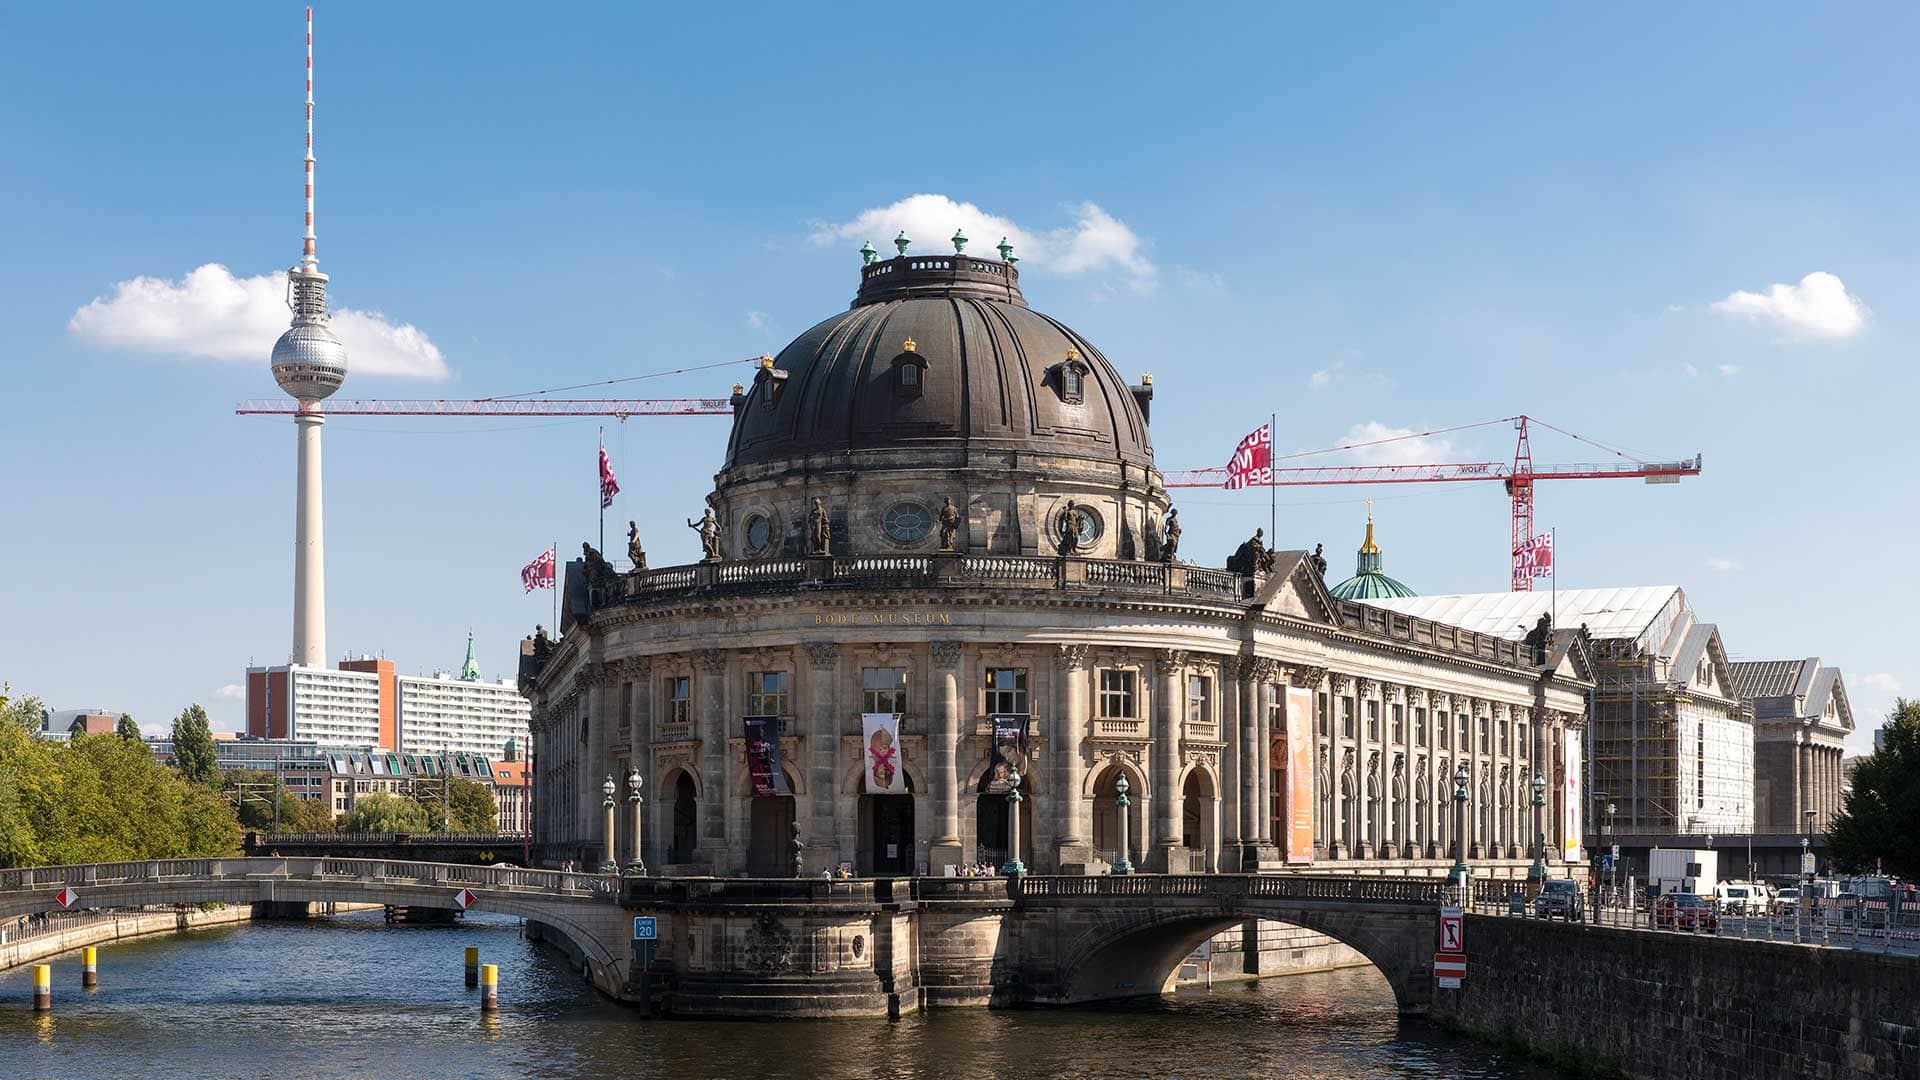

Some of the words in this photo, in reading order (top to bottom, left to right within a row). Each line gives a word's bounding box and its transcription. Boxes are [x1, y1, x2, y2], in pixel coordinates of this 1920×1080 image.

[815, 614, 857, 624] BODE
[873, 614, 949, 624] MUSEUM
[639, 926, 652, 937] 20
